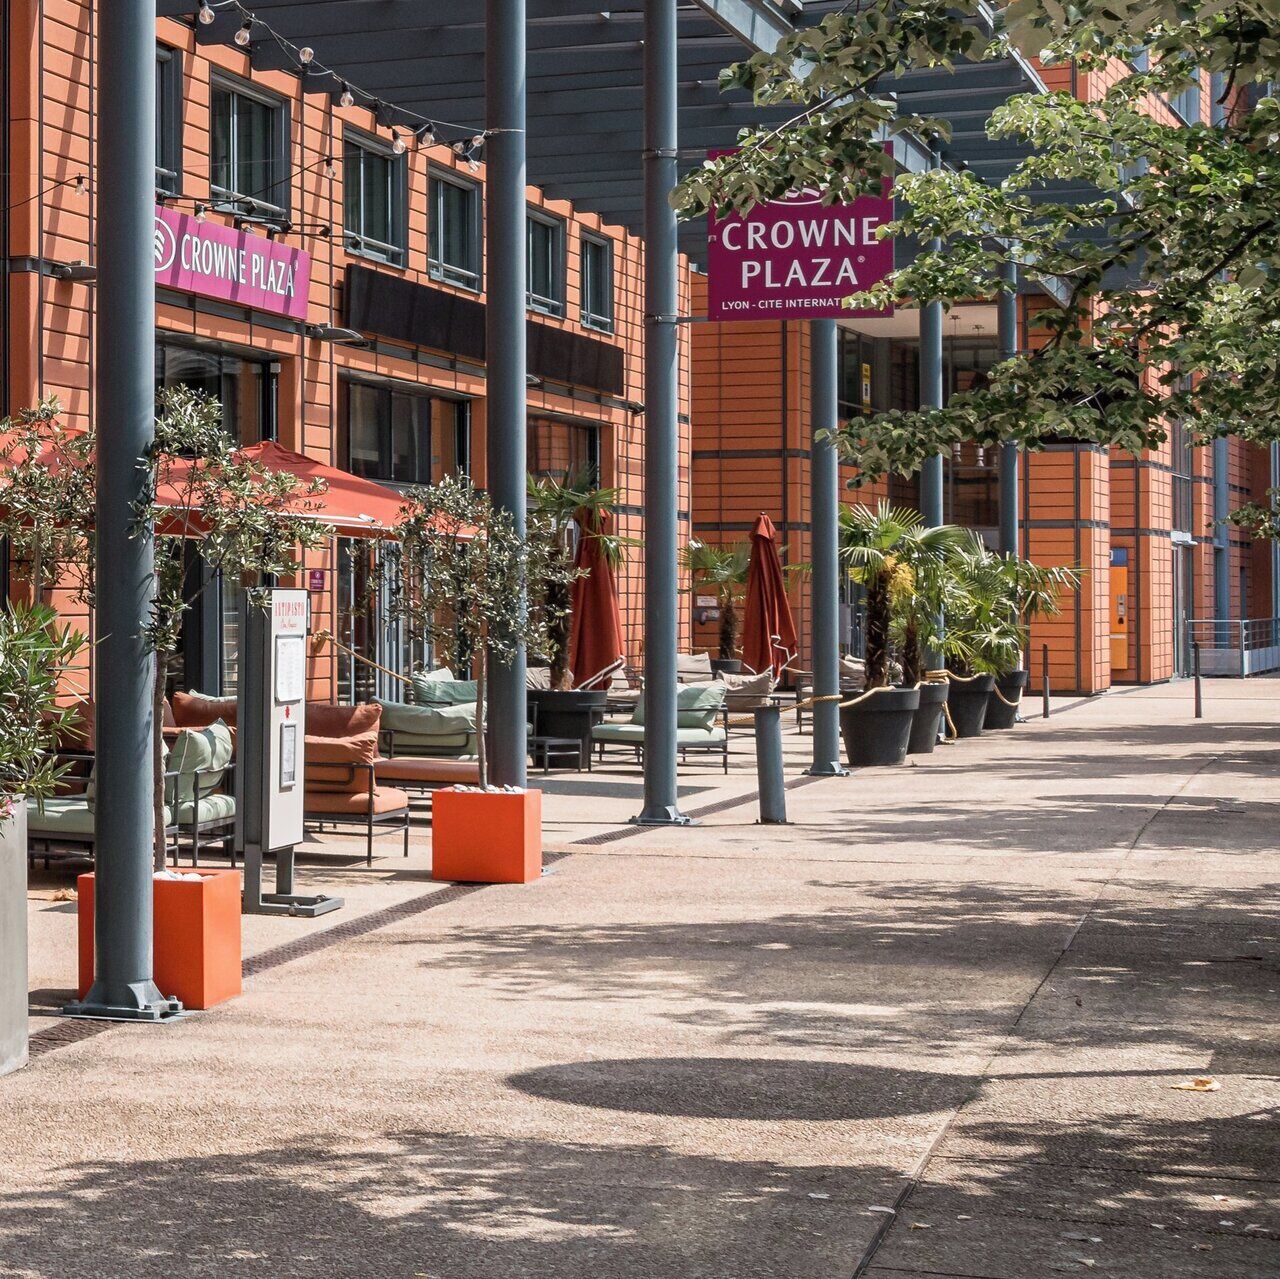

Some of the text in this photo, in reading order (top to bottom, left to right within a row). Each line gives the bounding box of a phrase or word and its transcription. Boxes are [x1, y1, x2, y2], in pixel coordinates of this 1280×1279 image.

[721, 217, 880, 251] CROWNE
[181, 233, 296, 298] CROWNE PLAZA
[721, 300, 750, 310] LYON
[758, 299, 783, 309] CITE
[785, 297, 843, 308] INTERNAT
